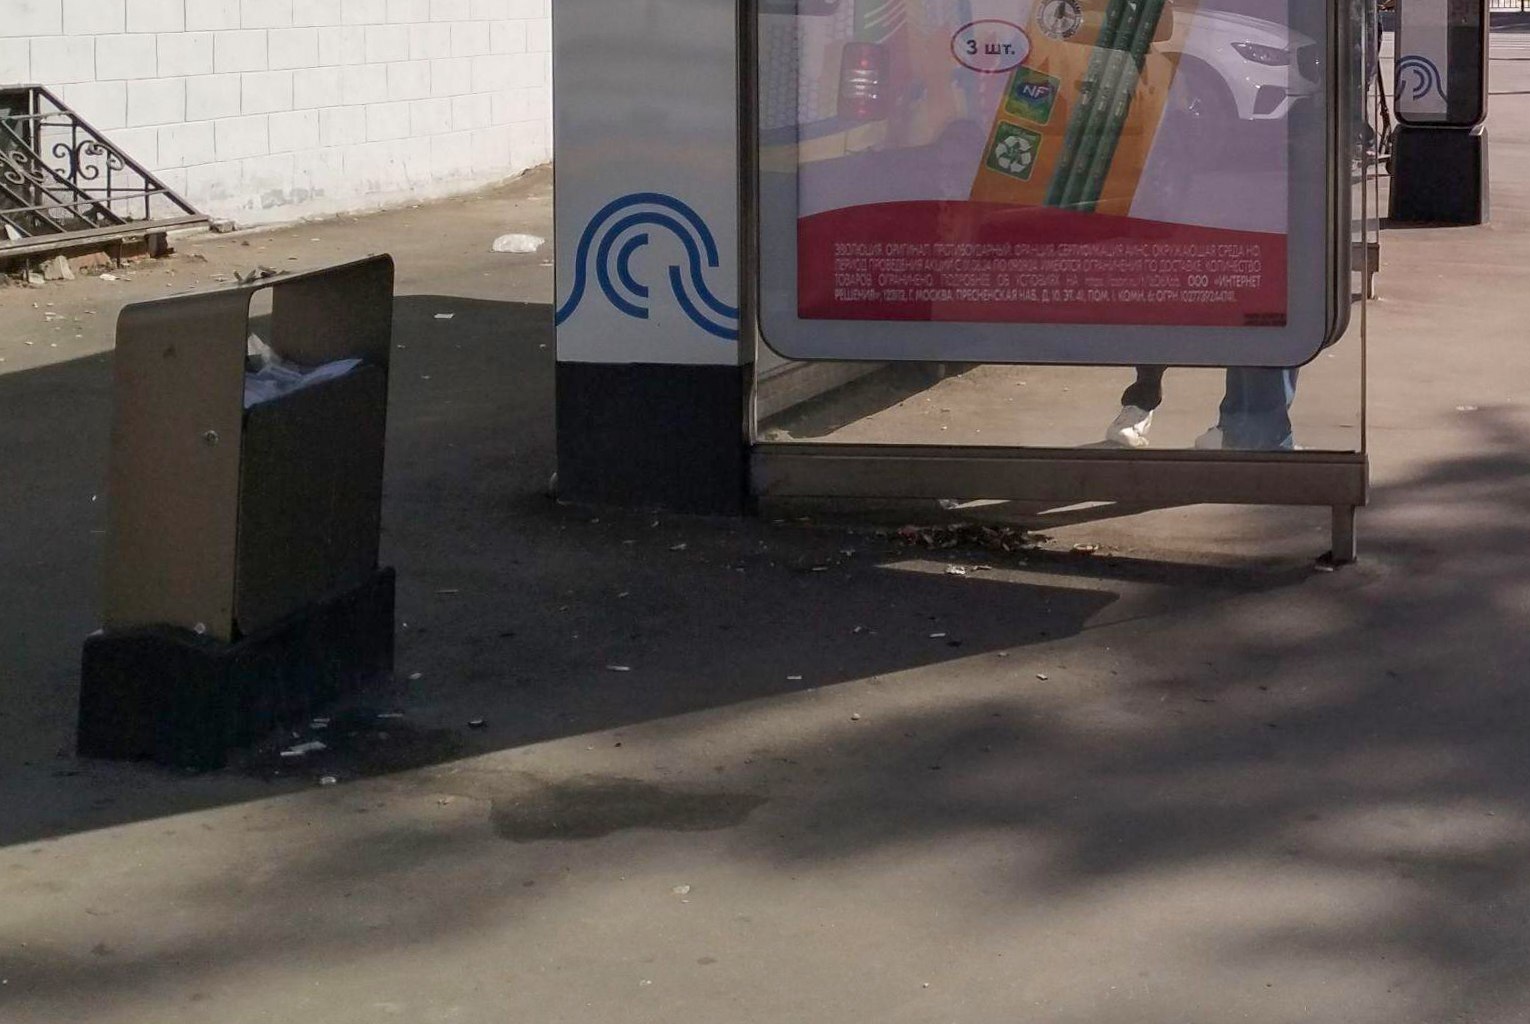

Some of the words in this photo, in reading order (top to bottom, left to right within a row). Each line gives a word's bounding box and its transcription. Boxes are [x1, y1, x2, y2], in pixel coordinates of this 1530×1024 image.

[966, 40, 977, 55] 3
[985, 43, 1015, 55] шт.
[1022, 84, 1050, 99] NF
